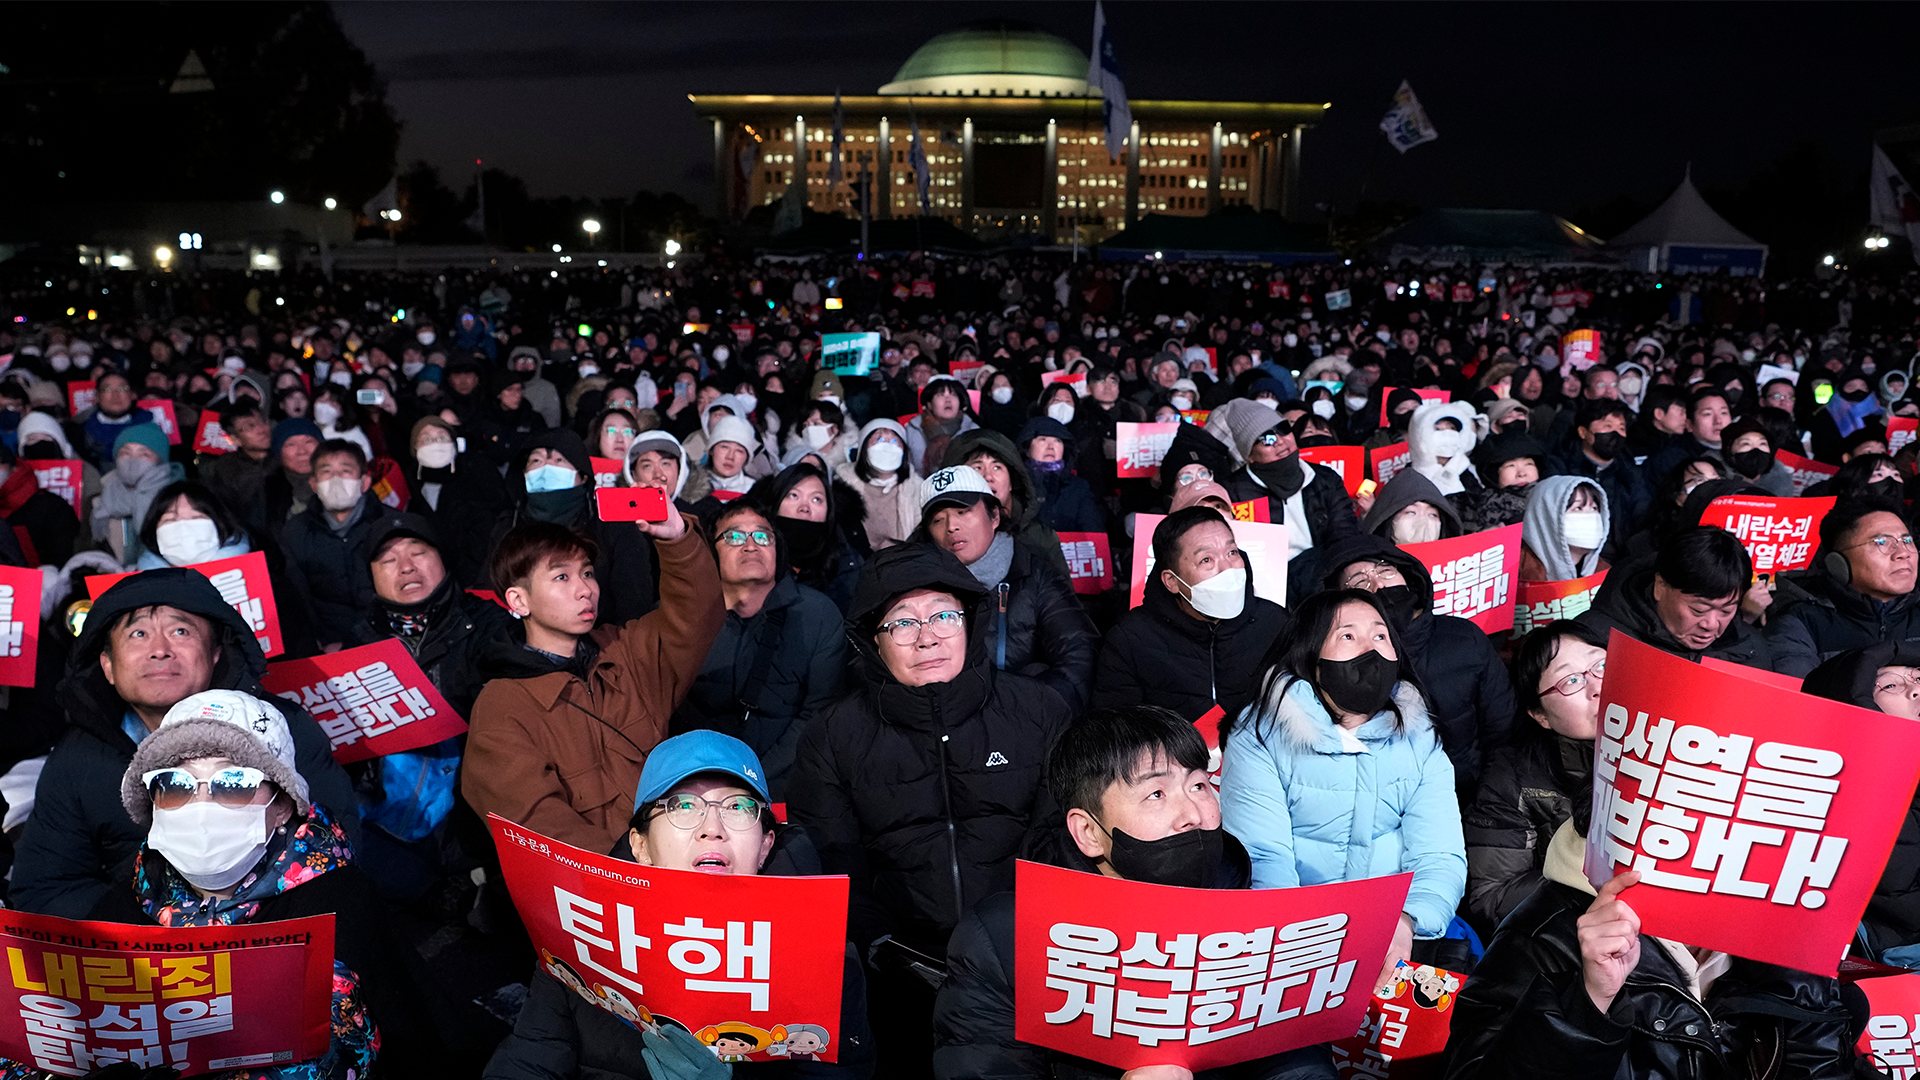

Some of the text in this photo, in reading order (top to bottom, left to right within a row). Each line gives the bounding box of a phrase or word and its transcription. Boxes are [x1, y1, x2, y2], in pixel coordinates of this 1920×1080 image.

[1725, 514, 1812, 542] 내란수괴
[1745, 543, 1811, 569] 열 체포
[1514, 584, 1601, 625] 윤석열
[318, 687, 437, 752] 부한다!
[743, 764, 758, 781] Lee
[1598, 702, 1844, 831] 윤석열을
[503, 828, 650, 888] 나눔문화 www.nanum.com
[1591, 777, 1849, 909] 거부한다!
[7, 947, 232, 1002] 내란죄
[553, 886, 772, 1012] 탄핵
[1046, 913, 1348, 992] 윤석열을
[19, 995, 234, 1046] 윤석열
[1044, 959, 1357, 1047] 거부한다!
